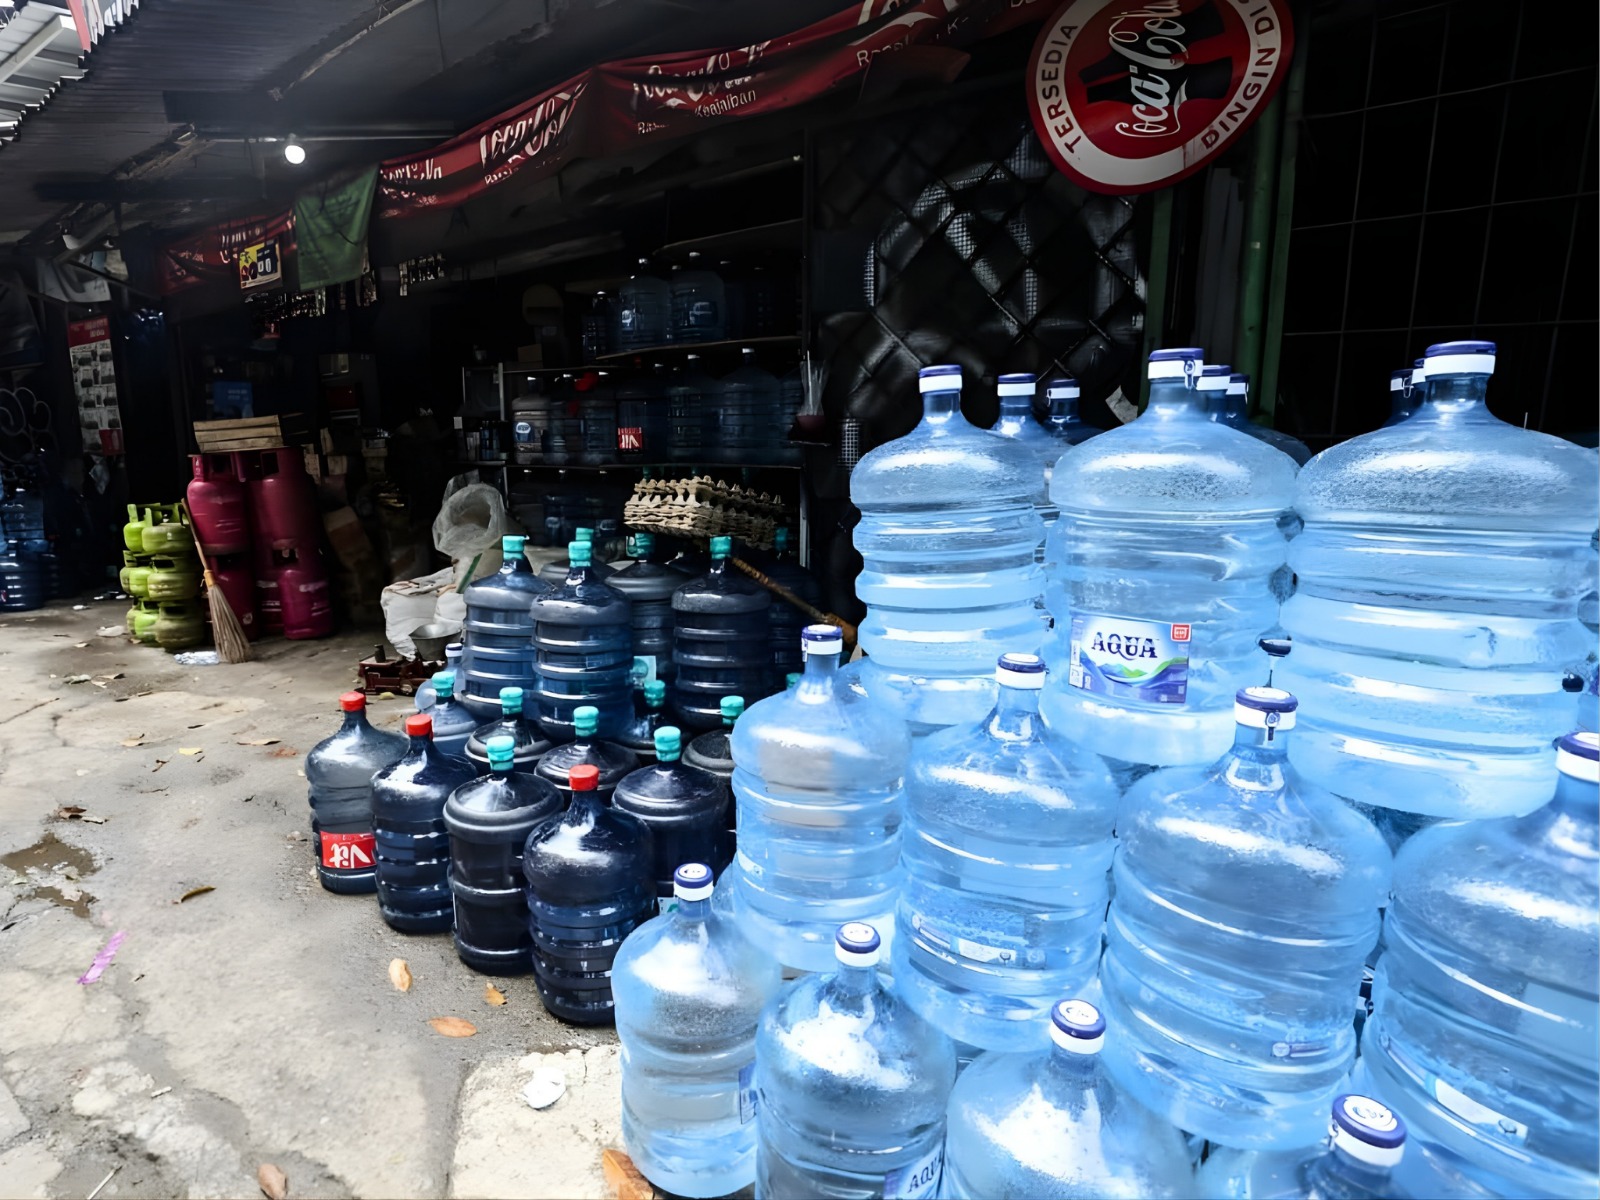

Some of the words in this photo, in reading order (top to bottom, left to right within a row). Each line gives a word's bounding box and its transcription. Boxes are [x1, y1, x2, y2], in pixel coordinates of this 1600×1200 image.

[1041, 24, 1082, 154] TERSEDIA
[1201, 46, 1277, 150] DINGIN
[1249, 5, 1276, 36] DI
[1091, 631, 1158, 661] AQUA
[329, 843, 371, 869] Vit
